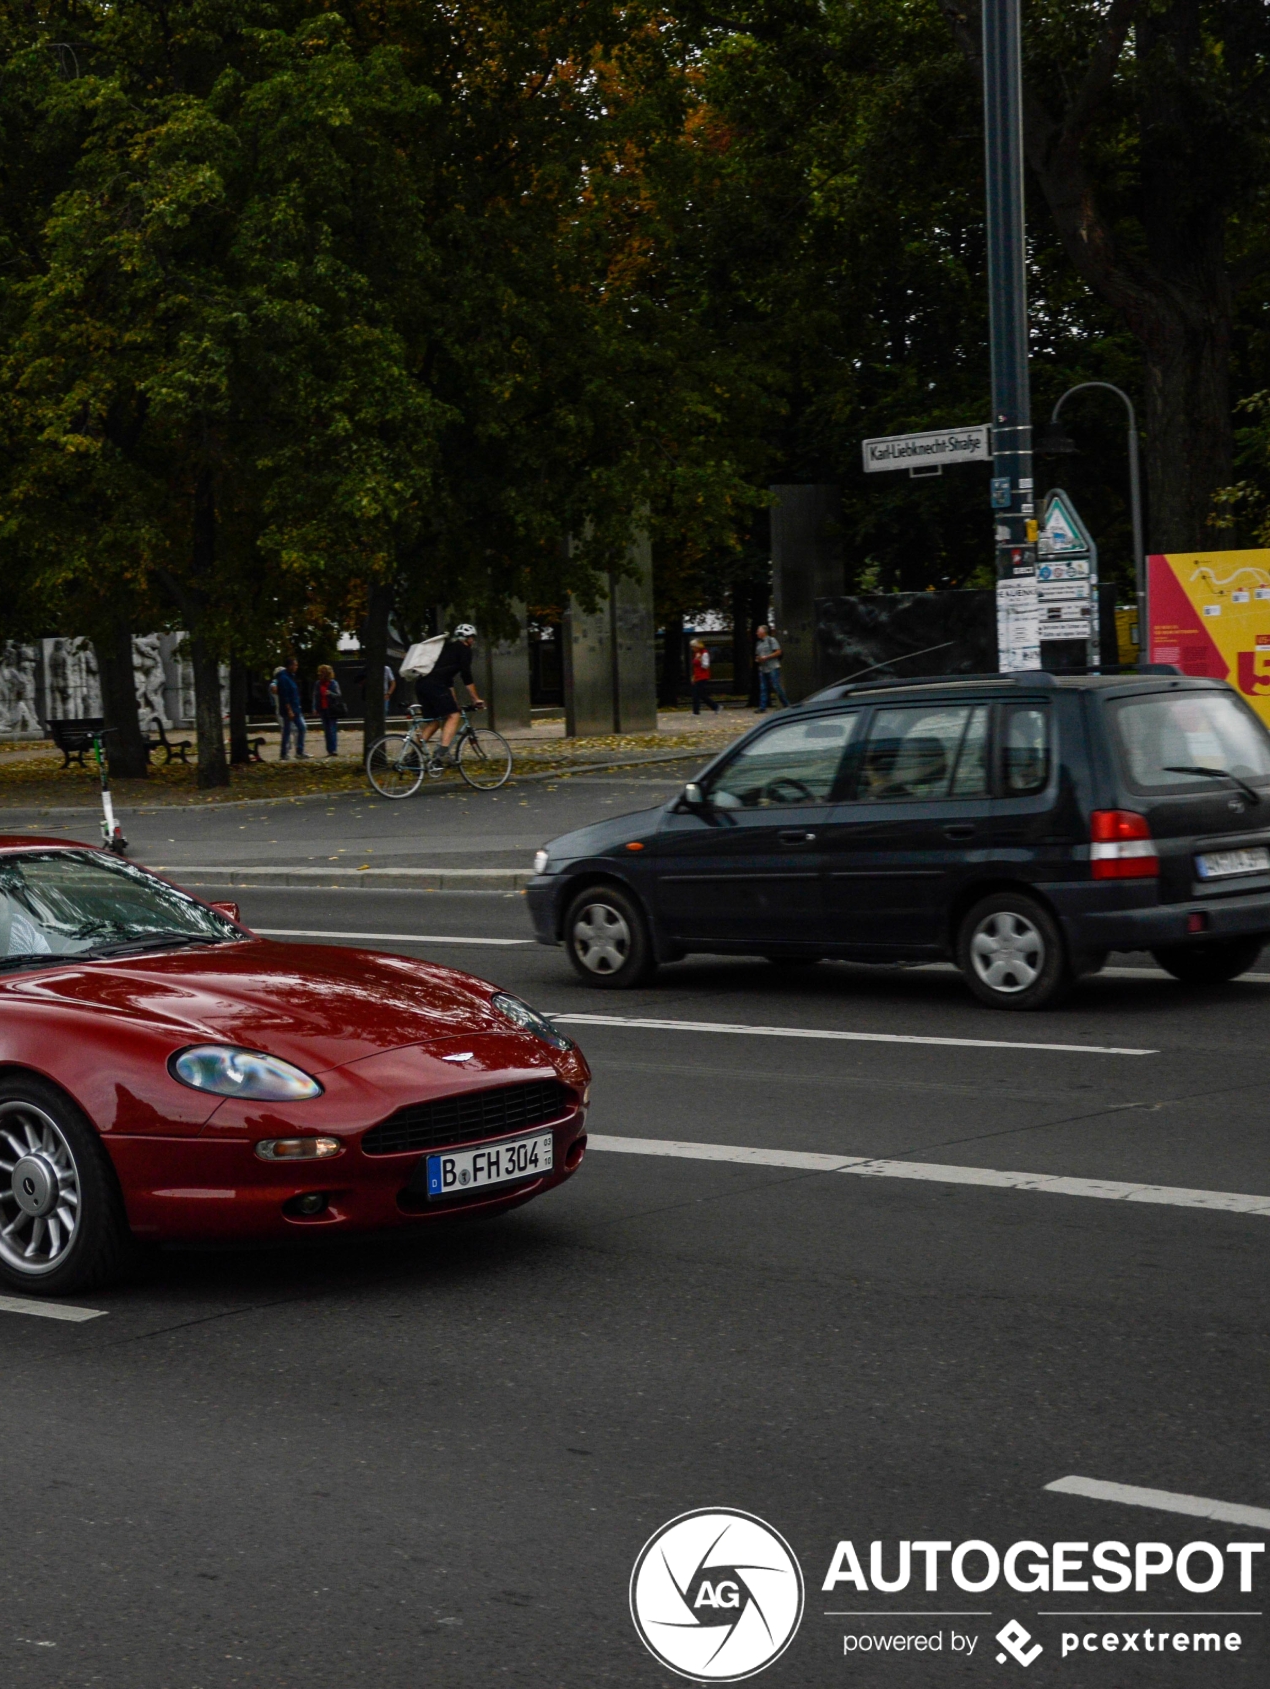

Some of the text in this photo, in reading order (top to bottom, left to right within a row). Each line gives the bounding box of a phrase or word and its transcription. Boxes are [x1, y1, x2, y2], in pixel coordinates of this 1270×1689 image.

[870, 435, 981, 461] Karl-Liebknecht-Straße
[544, 1138, 551, 1147] 03
[432, 1141, 539, 1188] D B FH 304
[544, 1157, 551, 1166] 10
